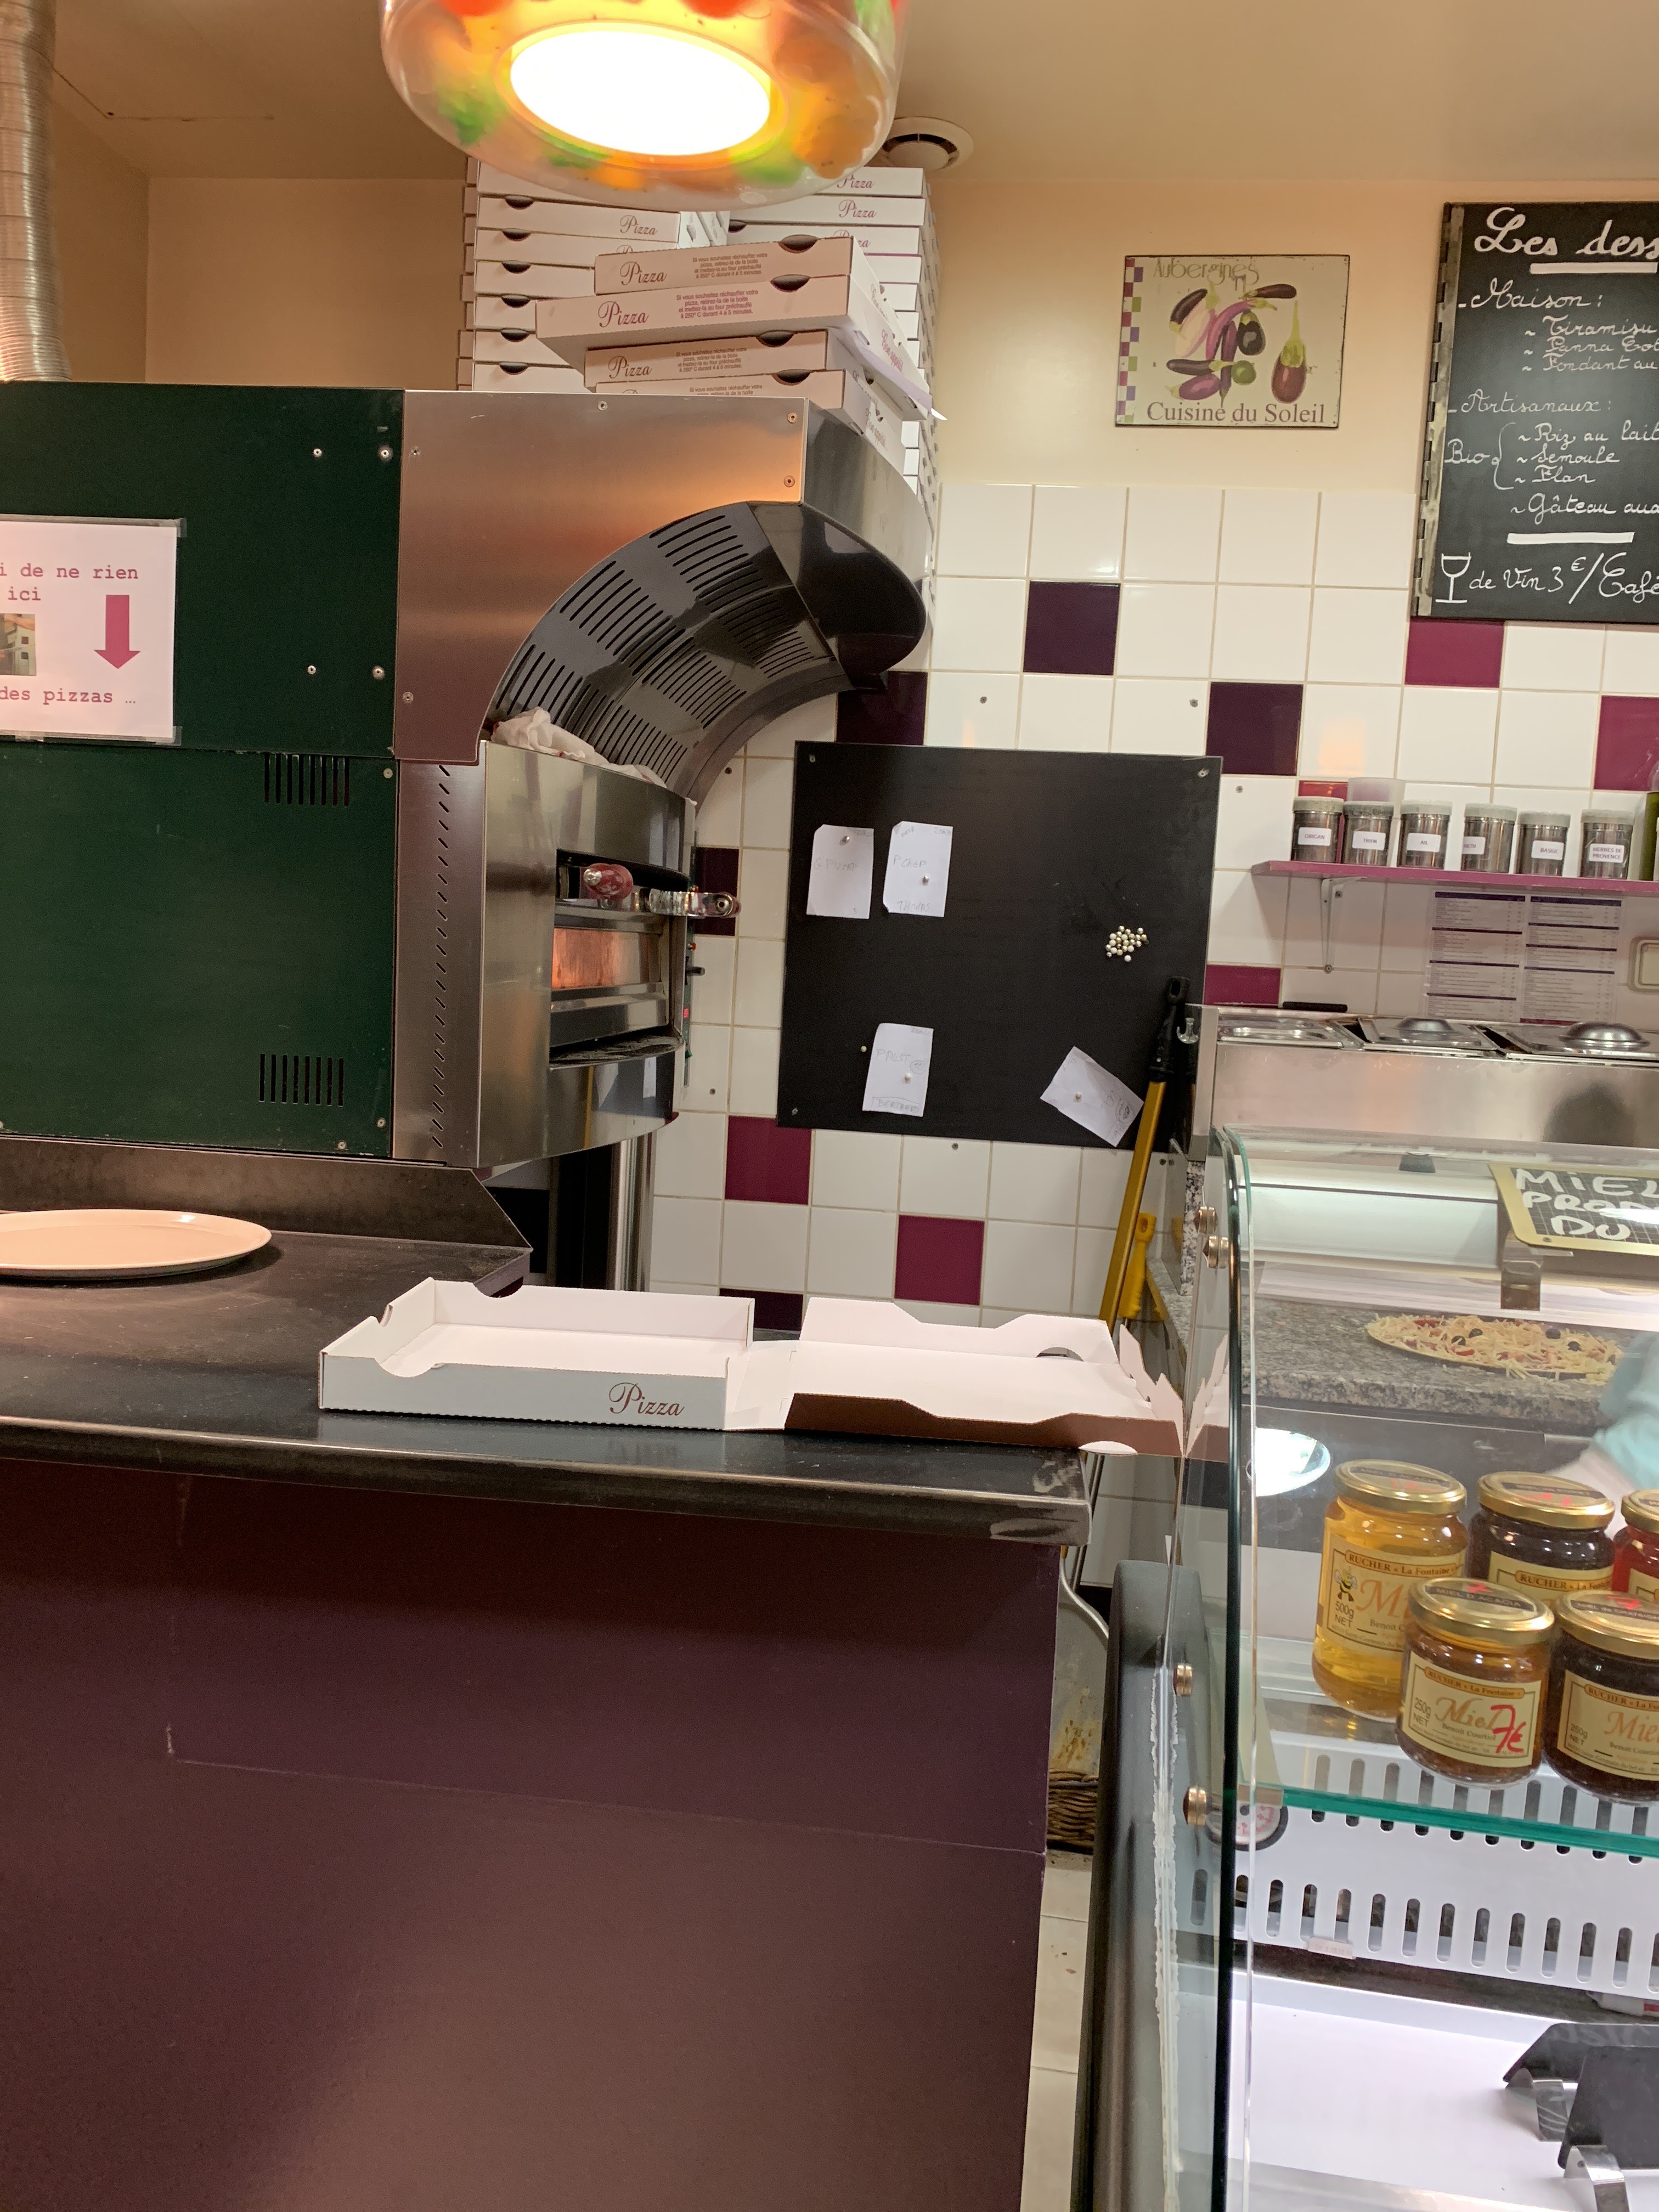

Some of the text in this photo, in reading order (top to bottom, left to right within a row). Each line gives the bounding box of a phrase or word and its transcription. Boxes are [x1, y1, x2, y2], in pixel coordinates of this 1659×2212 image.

[838, 199, 877, 218] Pizza
[620, 215, 658, 235] Pizza
[1474, 207, 1558, 256] Les
[620, 261, 668, 286] Pizza
[1153, 257, 1260, 285] Aubergines
[597, 301, 650, 328] Pizza
[726, 302, 752, 310] préchauffé
[1542, 314, 1657, 336] Tiramisu
[1545, 336, 1613, 354] Panna
[608, 356, 653, 379] Pizza
[1543, 352, 1658, 371] Fondant au
[1146, 402, 1325, 423] Cuisine du Soleil
[1584, 432, 1609, 441] au
[1444, 438, 1491, 464] Bio
[1531, 464, 1595, 483] Flan
[1528, 493, 1616, 525] Gâteau
[20, 563, 44, 578] de
[57, 566, 80, 579] ne
[93, 565, 138, 579] rien
[1469, 570, 1496, 589] de
[1503, 568, 1545, 590] Vin
[8, 586, 41, 601] ici
[0, 686, 31, 701] des
[43, 688, 113, 705] pizzas
[608, 1382, 685, 1416] Pizza
[1349, 1554, 1391, 1572] RUCHER
[1415, 1567, 1450, 1576] Fontaine
[1520, 1573, 1567, 1589] RUCHER
[1335, 1600, 1354, 1620] 500g
[1335, 1614, 1353, 1628] NET
[1428, 1671, 1462, 1688] RUCHER
[1482, 1686, 1515, 1696] Fontaine
[1588, 1687, 1627, 1705] RUCHER
[1414, 1697, 1431, 1719] 250g
[1435, 1696, 1503, 1730] Miel
[1413, 1713, 1430, 1728] NET
[1491, 1704, 1527, 1754] 7€
[1570, 1723, 1588, 1740] 250g
[1570, 1734, 1585, 1745] NET
